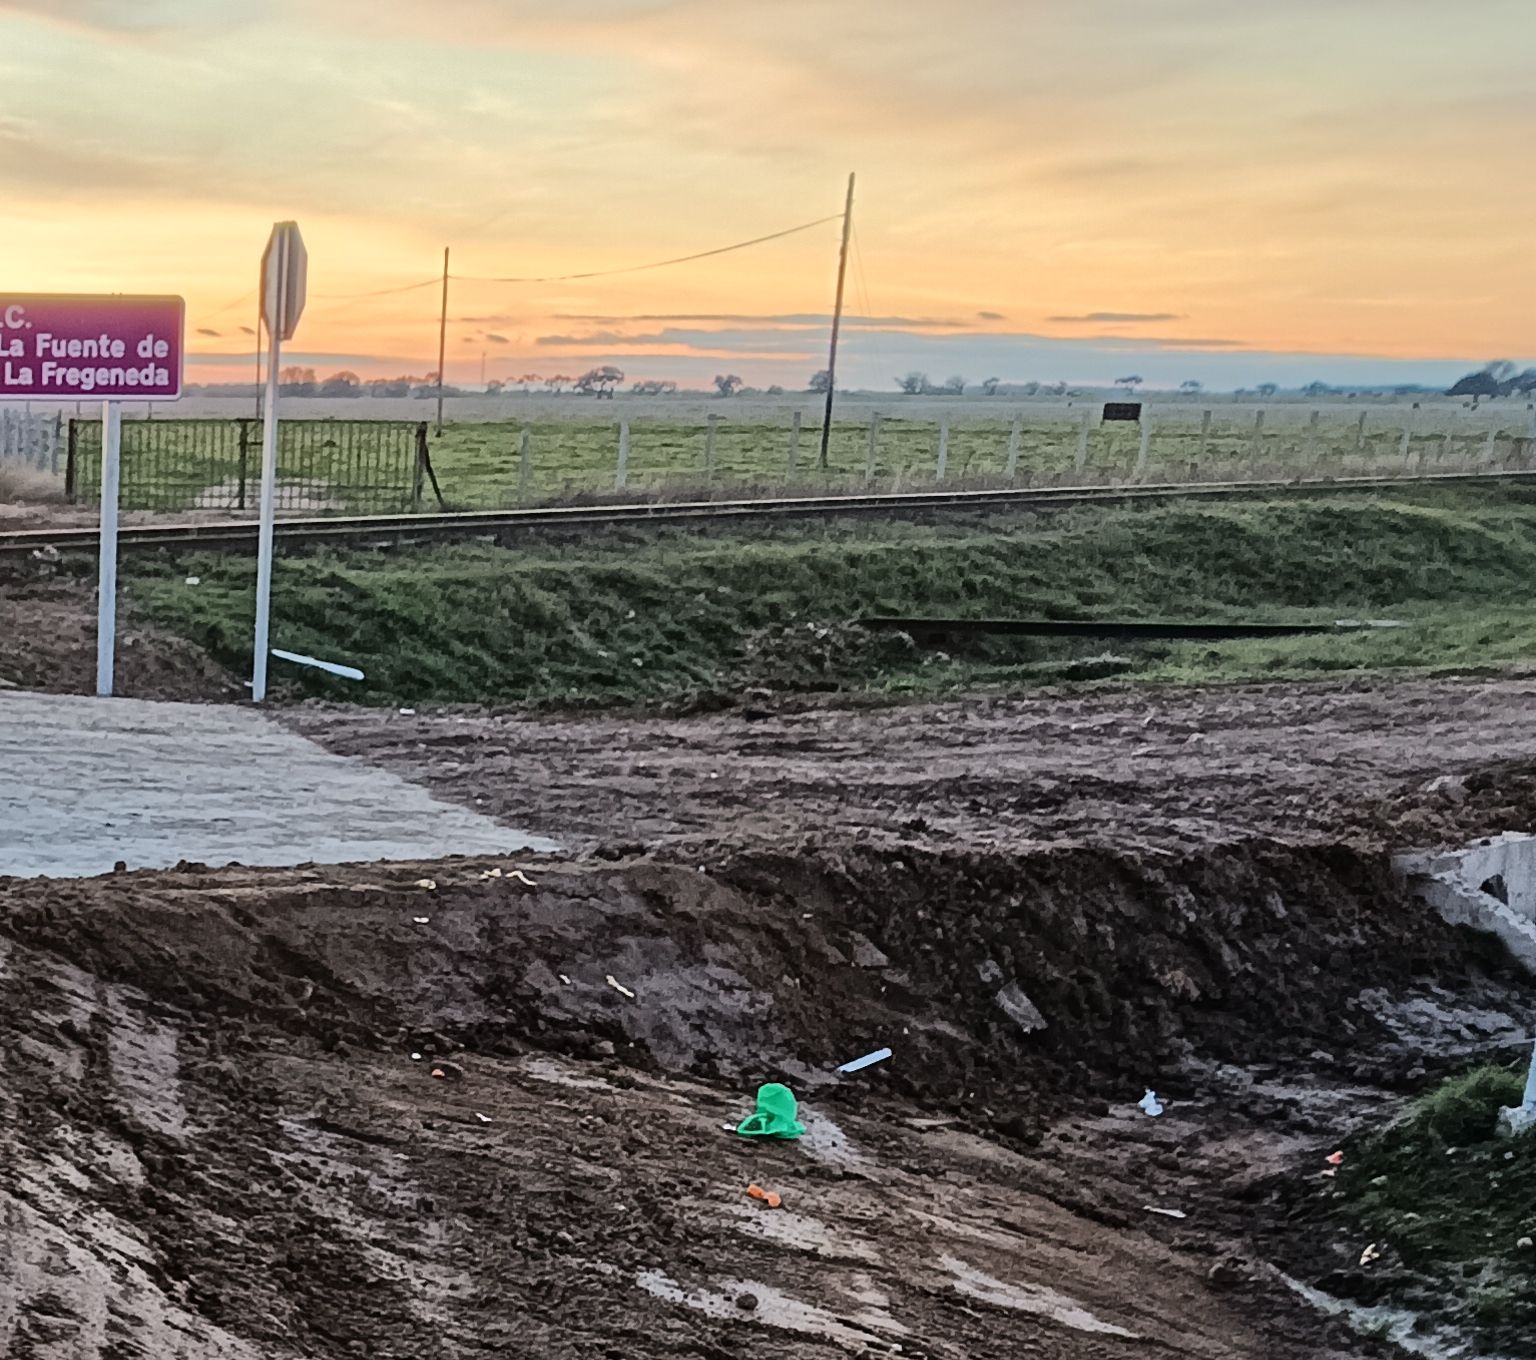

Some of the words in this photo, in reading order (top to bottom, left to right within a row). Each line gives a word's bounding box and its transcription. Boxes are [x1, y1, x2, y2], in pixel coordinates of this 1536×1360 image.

[35, 333, 126, 359] Fuente
[136, 333, 169, 359] de
[4, 361, 34, 386] La
[41, 361, 170, 391] Fregeneda
